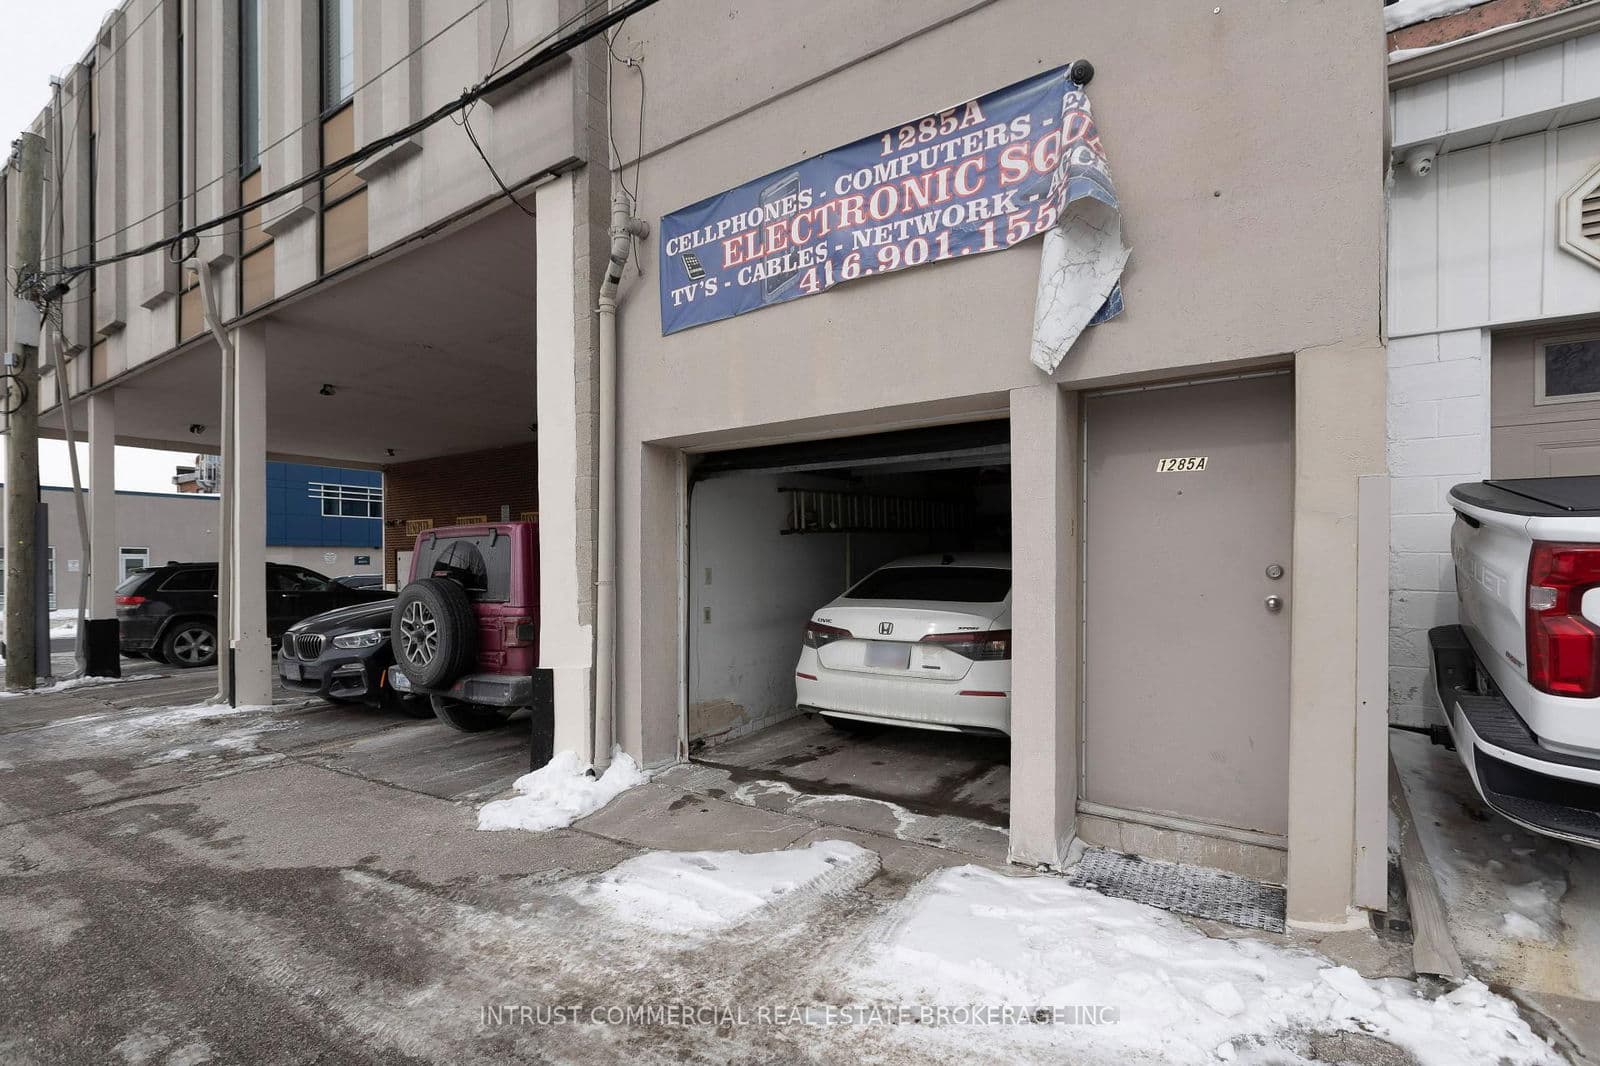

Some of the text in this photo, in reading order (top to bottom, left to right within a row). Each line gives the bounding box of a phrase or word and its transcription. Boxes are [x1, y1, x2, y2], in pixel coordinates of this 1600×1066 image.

[666, 188, 813, 256] CELLPHONES
[835, 114, 1031, 195] COMPUTERS
[880, 100, 986, 157] 1285A
[672, 277, 718, 307] TV'S
[738, 240, 828, 286] CABLES
[852, 189, 1019, 250] NETWORK
[722, 156, 986, 269] ELECTRONIC
[1160, 457, 1205, 471] 1285A
